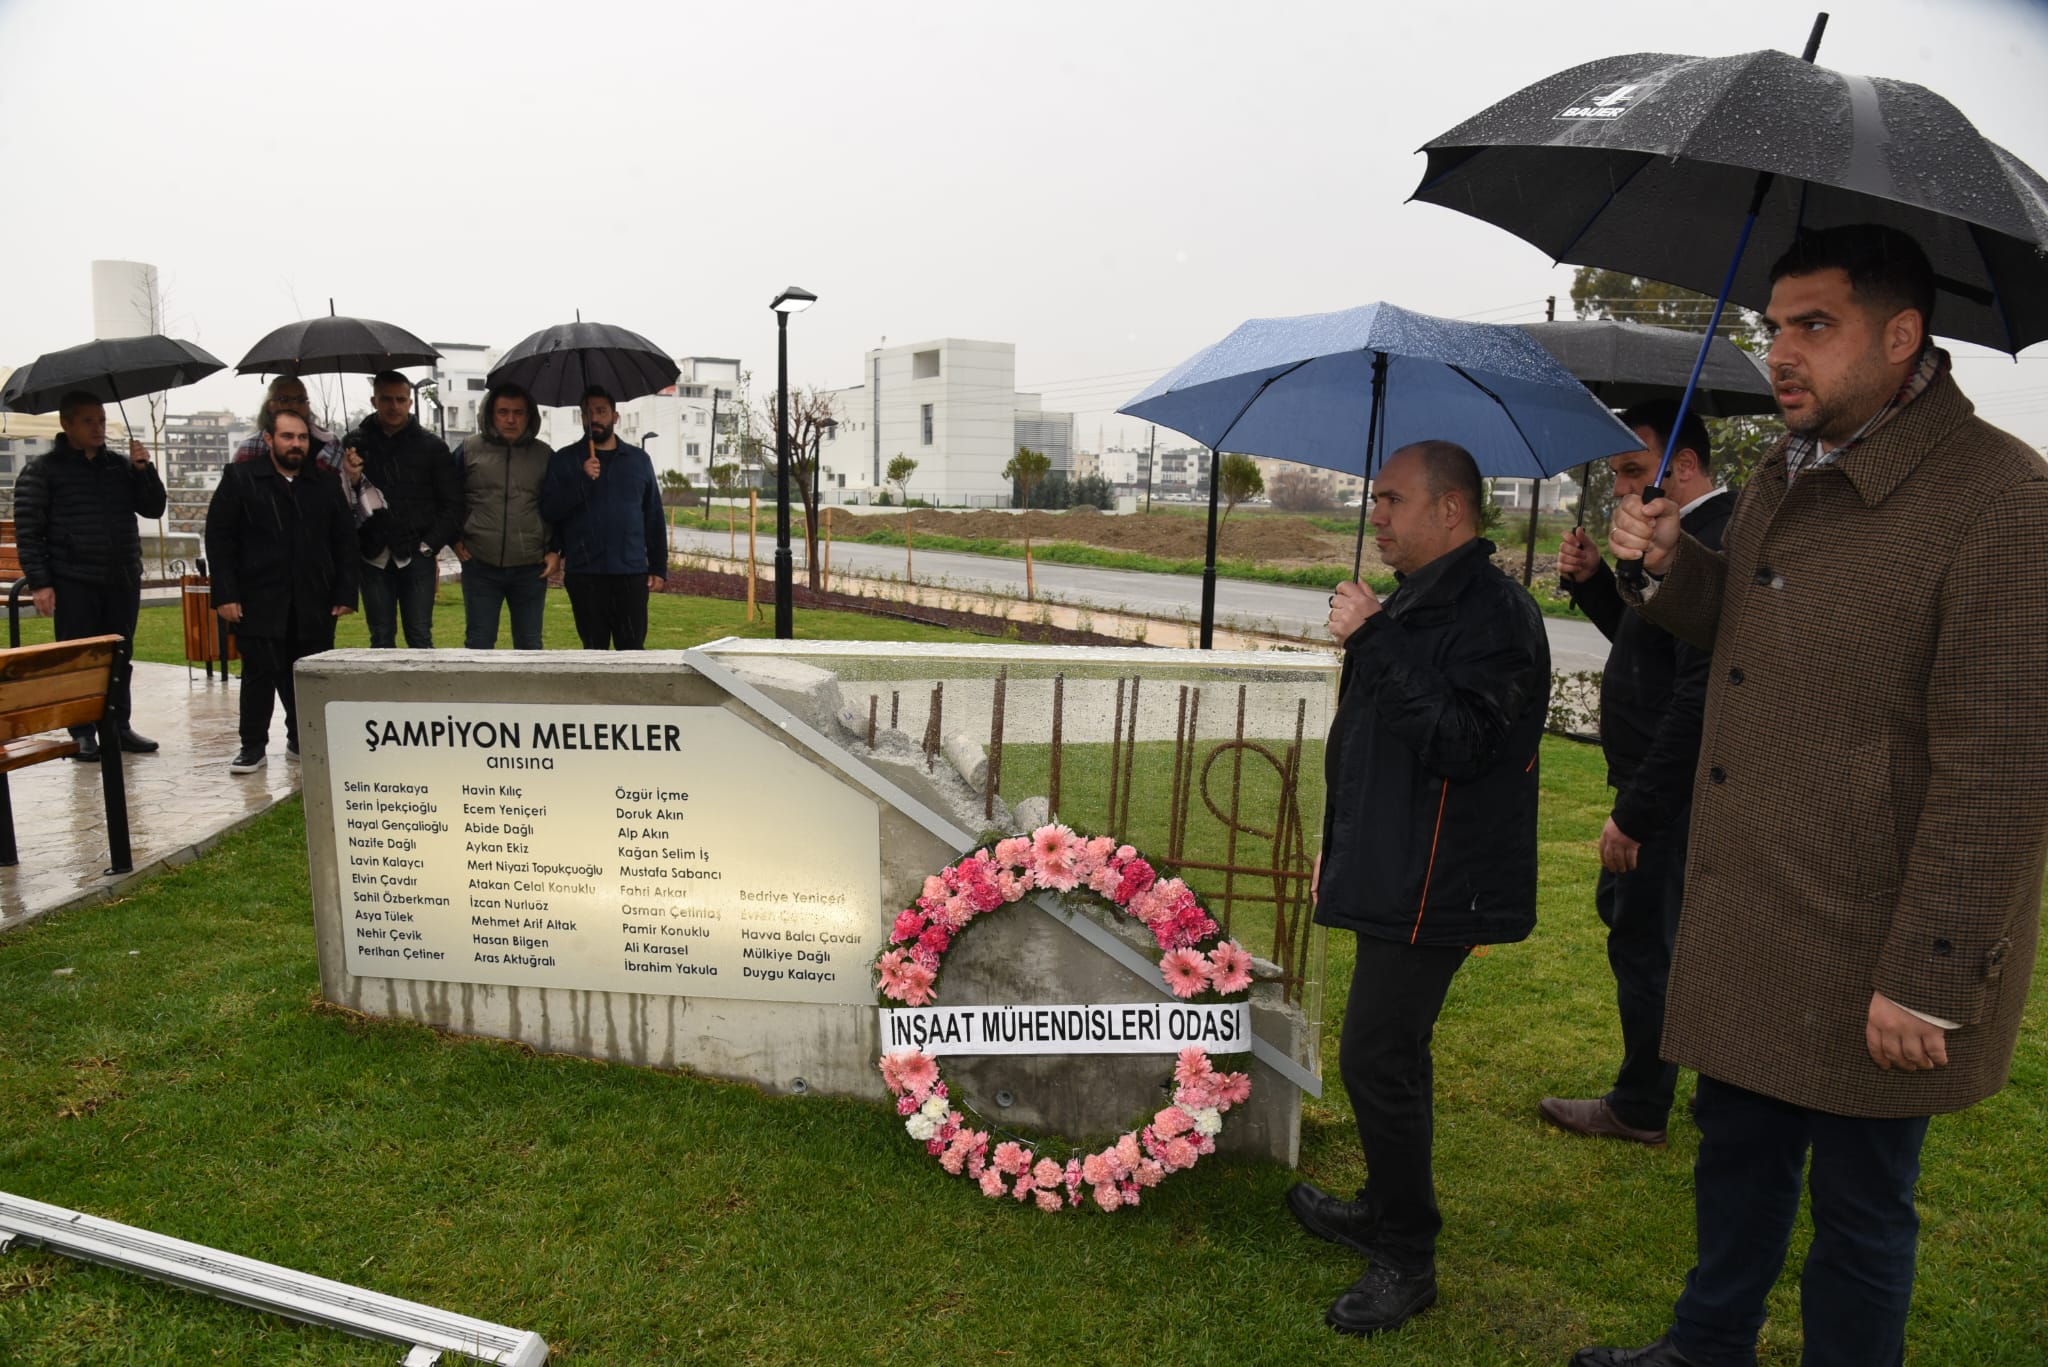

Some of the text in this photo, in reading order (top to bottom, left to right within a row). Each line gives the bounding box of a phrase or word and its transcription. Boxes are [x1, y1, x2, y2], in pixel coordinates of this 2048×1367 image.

[1560, 108, 1625, 117] BAUER
[365, 715, 681, 751] ŞAMPİYON MELEKLER
[486, 756, 554, 770] anısına
[344, 781, 429, 795] Selin Karakaya
[462, 785, 522, 798] Havin Kılıç
[615, 786, 688, 802] Özgür İçme
[346, 799, 437, 815] Serin İpekçioğlu
[463, 804, 547, 818] Ecem Yeniçeri
[616, 808, 683, 820] Doruk Akın
[347, 818, 448, 834] Hayal Gençalioğlu
[465, 822, 534, 837] Abide Dağlı
[618, 828, 669, 840] Alp Akın
[349, 836, 416, 851] Nazife Dağlı
[466, 842, 529, 853] Aykan Ekiz
[618, 847, 709, 862] Kağan Selim İş
[351, 855, 424, 869] Lavin Kalaycı
[467, 860, 603, 877] Mert Niyazi Topukçuoğlu
[352, 873, 417, 886] Elvin Çavdır
[620, 866, 721, 879] Mustafa Sabancı
[469, 879, 596, 894] Atakan Celal Konuklu
[620, 885, 687, 898] Fahri Arkar
[354, 891, 450, 905] Sahil Özberkman
[470, 895, 549, 911] İzcan Nurluöz
[740, 890, 788, 903] Bedriye
[355, 910, 414, 922] Asya Tülek
[622, 904, 666, 916] Osman
[472, 916, 577, 930] Mehmet Arif Altak
[622, 923, 710, 937] Pamir Konuklu
[357, 928, 422, 941] Nehir Çevik
[473, 934, 548, 949] Hasan Bilgen
[741, 929, 861, 944] Havva Balcı Çavdır
[358, 946, 445, 960] Perihan Çetiner
[625, 942, 688, 955] Ali Karasel
[474, 952, 555, 967] Aras Aktuğralı
[743, 948, 830, 964] Mülkiye Dağlı
[625, 958, 717, 975] İbrahim Yakula
[743, 967, 835, 983] Duygu Kalaycı
[890, 1004, 1240, 1052] İNŞAAT MÜHENDİSLERİ ODASI
